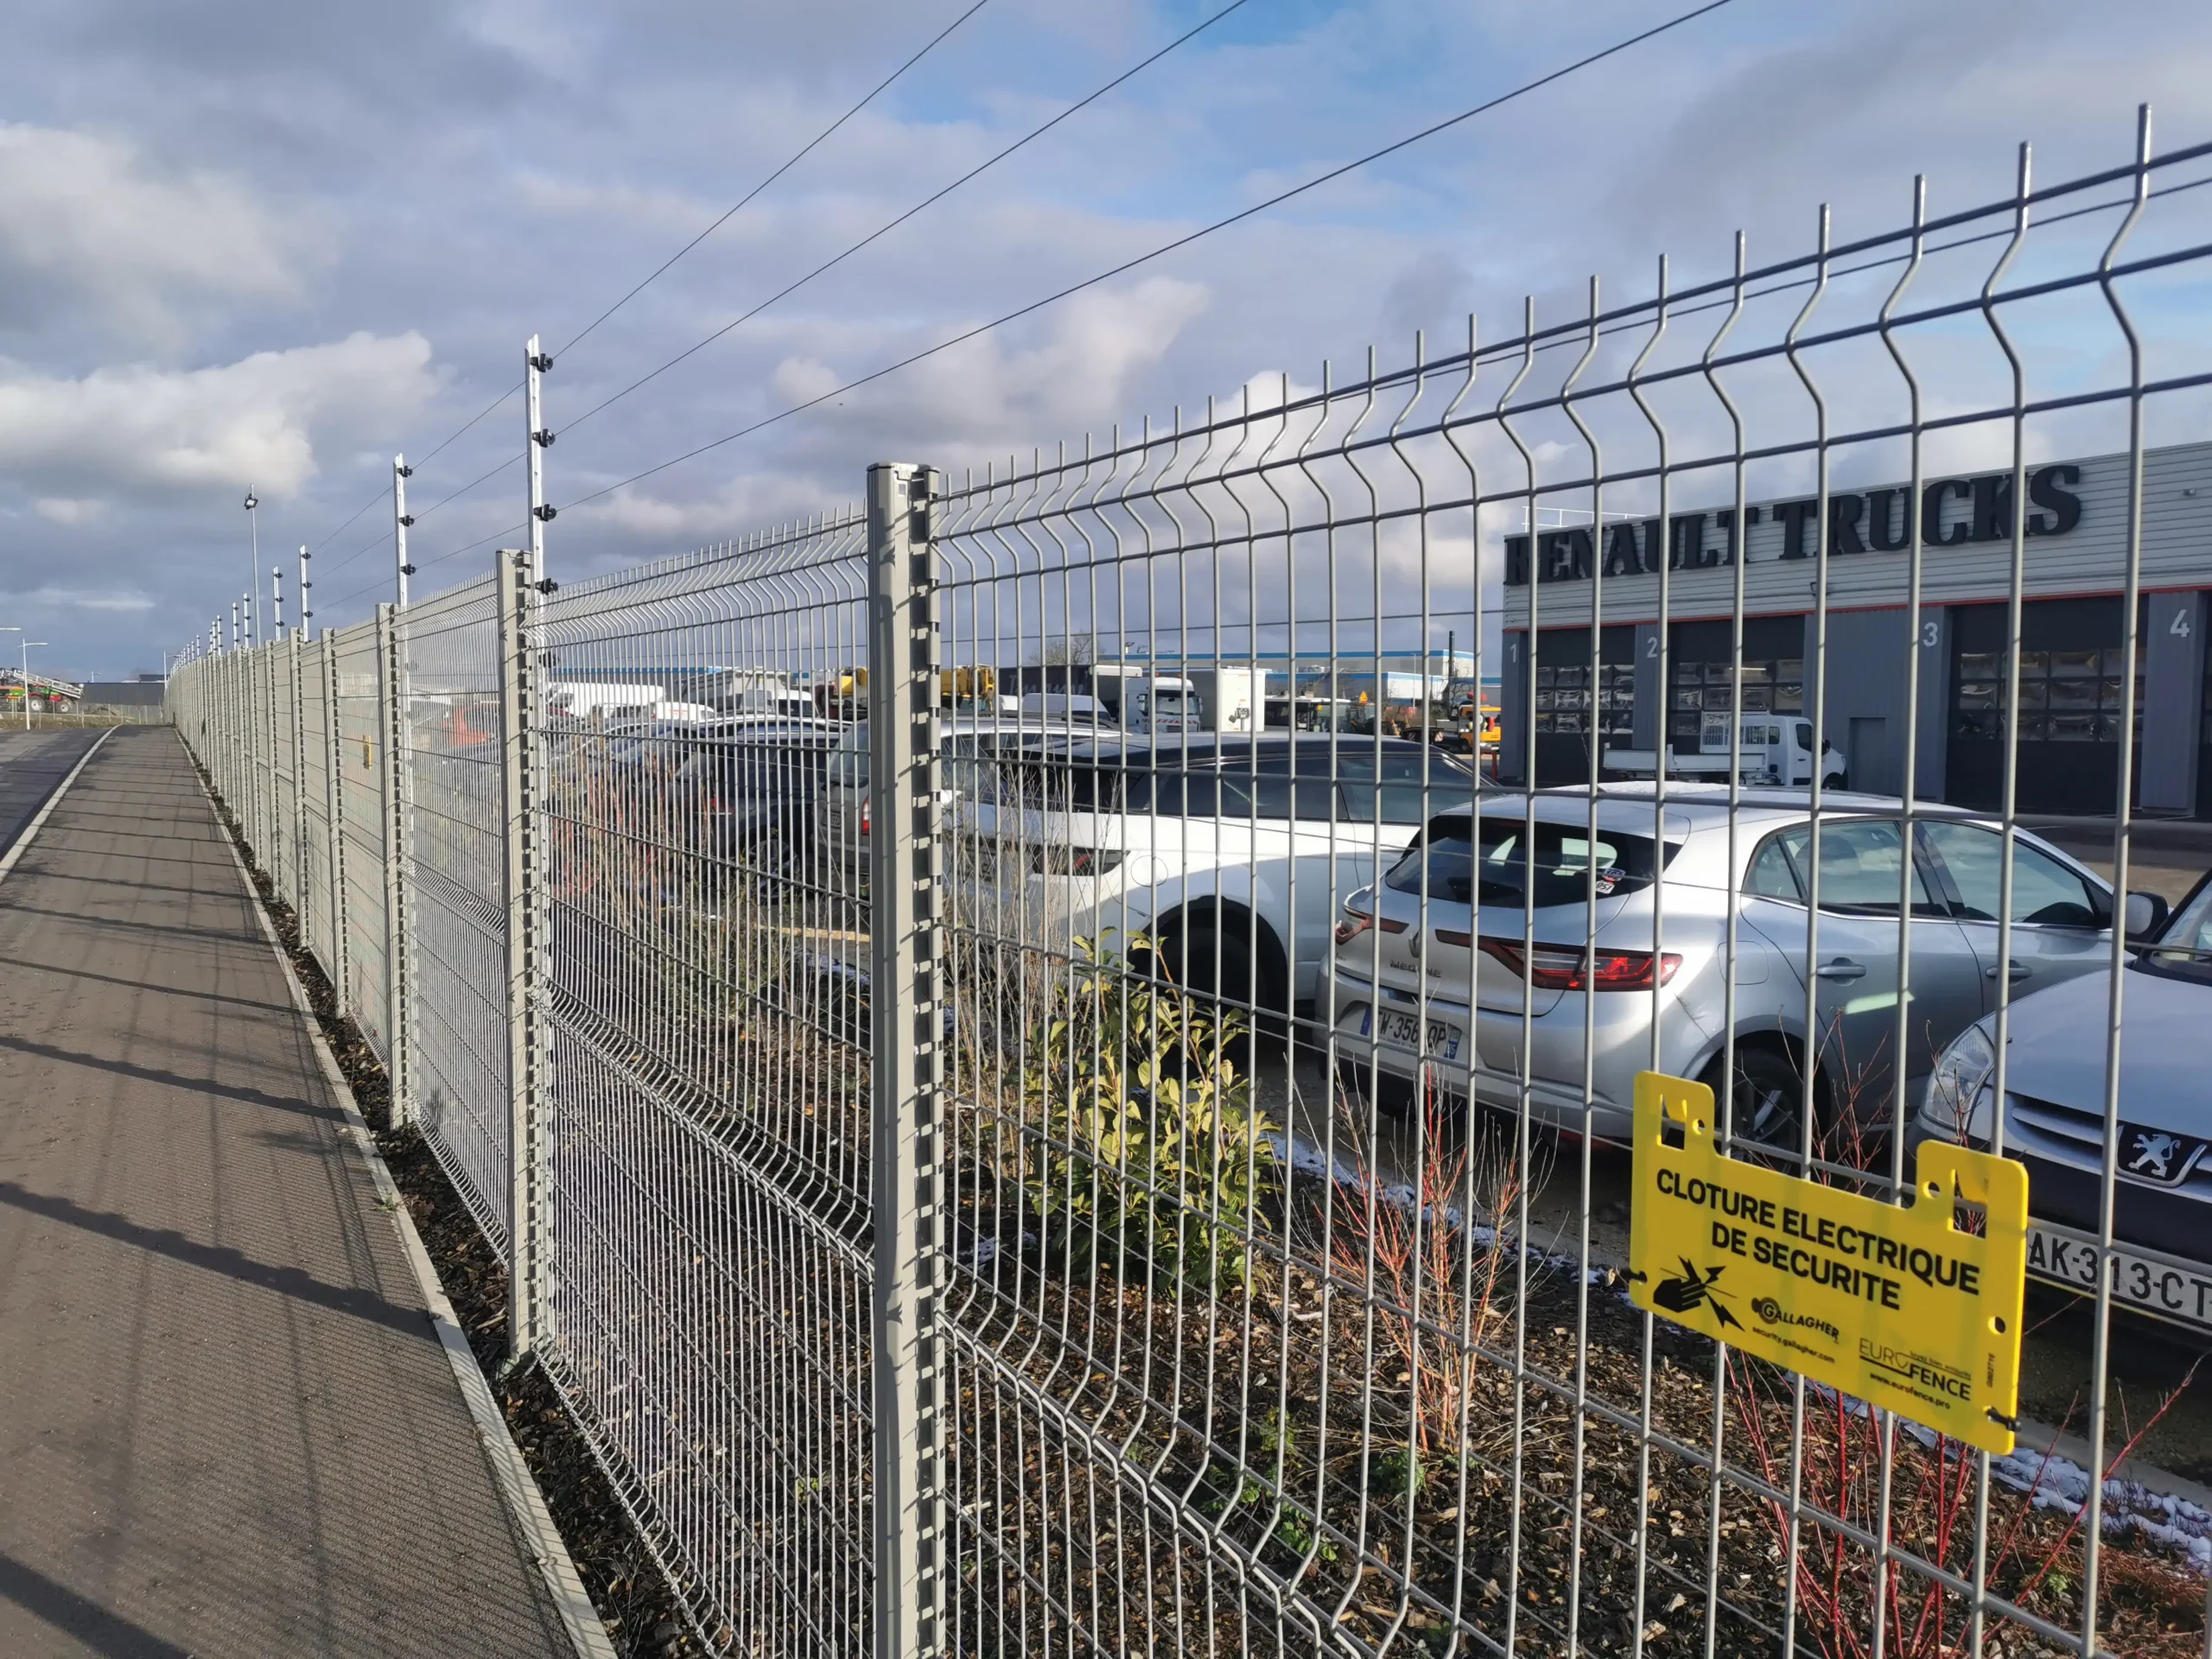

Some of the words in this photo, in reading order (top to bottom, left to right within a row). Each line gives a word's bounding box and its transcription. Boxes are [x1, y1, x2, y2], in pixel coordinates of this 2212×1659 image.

[1503, 506, 1759, 586] RENAULT
[1773, 465, 2082, 560] TRUCKS
[1923, 621, 1938, 647] 3
[2170, 609, 2190, 638] 4
[1510, 643, 1517, 663] 1
[1647, 636, 1658, 658] 2
[1389, 959, 1442, 978] MEGNE
[1374, 1009, 1447, 1049] W-356QP
[1656, 1168, 1777, 1230] CLOTURE
[1782, 1206, 1980, 1295] ELECTRIQUE
[1711, 1220, 1747, 1257] DE
[1752, 1236, 1900, 1311] SECURITE
[2028, 1231, 2212, 1318] AK-313-CT
[1763, 1303, 1840, 1341] GALLAGHER
[1869, 1372, 1951, 1410] www.eurofence.pro
